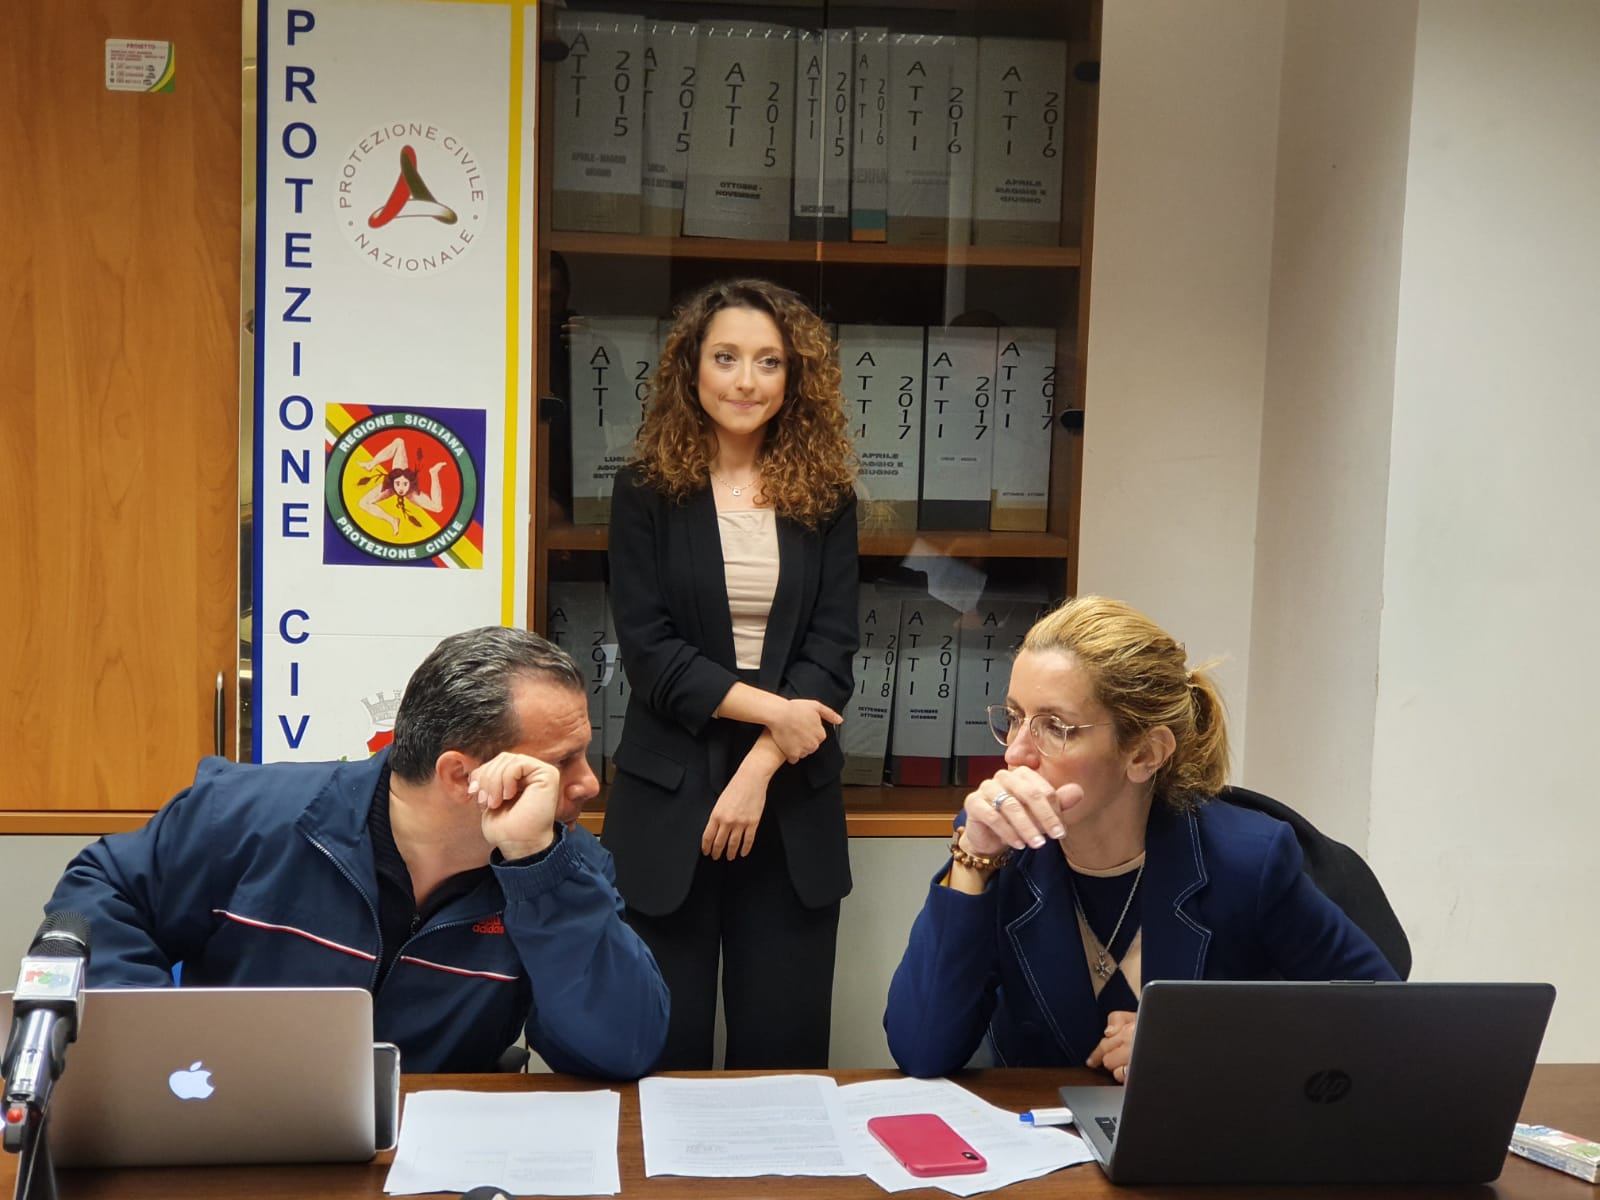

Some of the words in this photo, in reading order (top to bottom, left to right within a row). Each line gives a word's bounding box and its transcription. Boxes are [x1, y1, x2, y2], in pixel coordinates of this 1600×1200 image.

[570, 32, 590, 118] ATTI
[613, 50, 631, 137] 2015
[675, 66, 697, 152] 2015
[724, 61, 746, 148] ATTI
[806, 55, 821, 140] ATTI
[834, 71, 848, 157] 2015
[858, 53, 870, 145] ATTI
[876, 78, 887, 146] 2016
[906, 61, 927, 151] ATTI
[1001, 65, 1022, 156] ATTI
[763, 81, 780, 168] 2015
[947, 87, 965, 154] 2016
[1042, 92, 1058, 158] 2016
[339, 123, 438, 208] PROTEZIONE
[443, 136, 484, 202] CIVILE
[279, 9, 317, 538] PROTEZIONE
[354, 229, 474, 271] NAZIONALE
[590, 345, 611, 428] ATTI
[635, 361, 651, 440] 201
[856, 351, 876, 439] ATTI
[897, 376, 914, 440] 2017
[932, 352, 953, 439] ATTI
[974, 376, 991, 441] 2017
[1001, 341, 1021, 429] ATTI
[1041, 366, 1056, 431] 2017
[338, 414, 395, 453] REGIONE
[404, 414, 465, 457] SICILIANA
[337, 516, 417, 559] PROTEZIONE
[426, 520, 463, 553] CIVILE
[278, 608, 311, 749] CIV
[860, 609, 877, 695] ATTI
[881, 634, 897, 698] 2018
[908, 611, 924, 696] ATTI
[937, 635, 953, 699] 2018
[983, 611, 998, 696] ATTI
